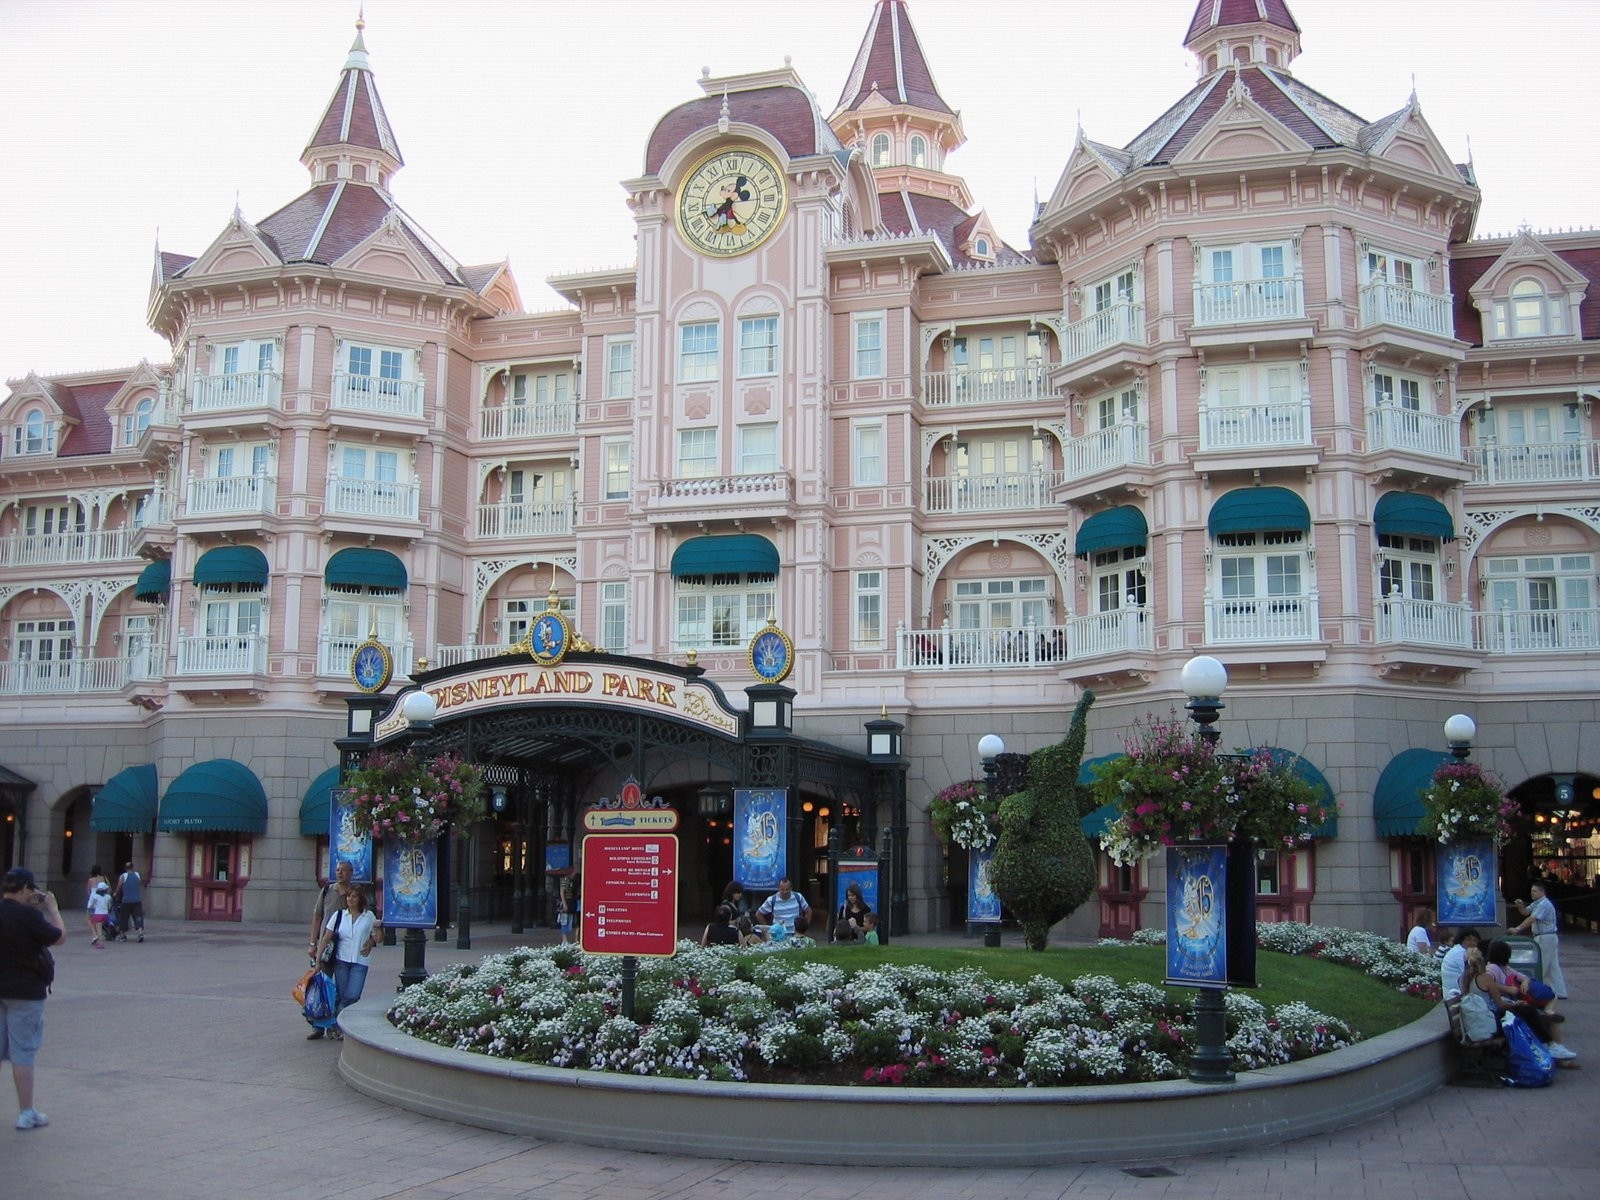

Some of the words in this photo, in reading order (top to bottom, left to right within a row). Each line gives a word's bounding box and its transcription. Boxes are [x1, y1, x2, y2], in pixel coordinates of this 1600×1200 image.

[726, 159, 737, 171] XII
[707, 166, 718, 179] XI
[764, 194, 774, 202] III
[429, 671, 593, 709] DISNEYLAND
[602, 672, 677, 708] PARK
[1560, 790, 1568, 799] 5
[496, 798, 502, 806] 8
[720, 800, 726, 809] 7
